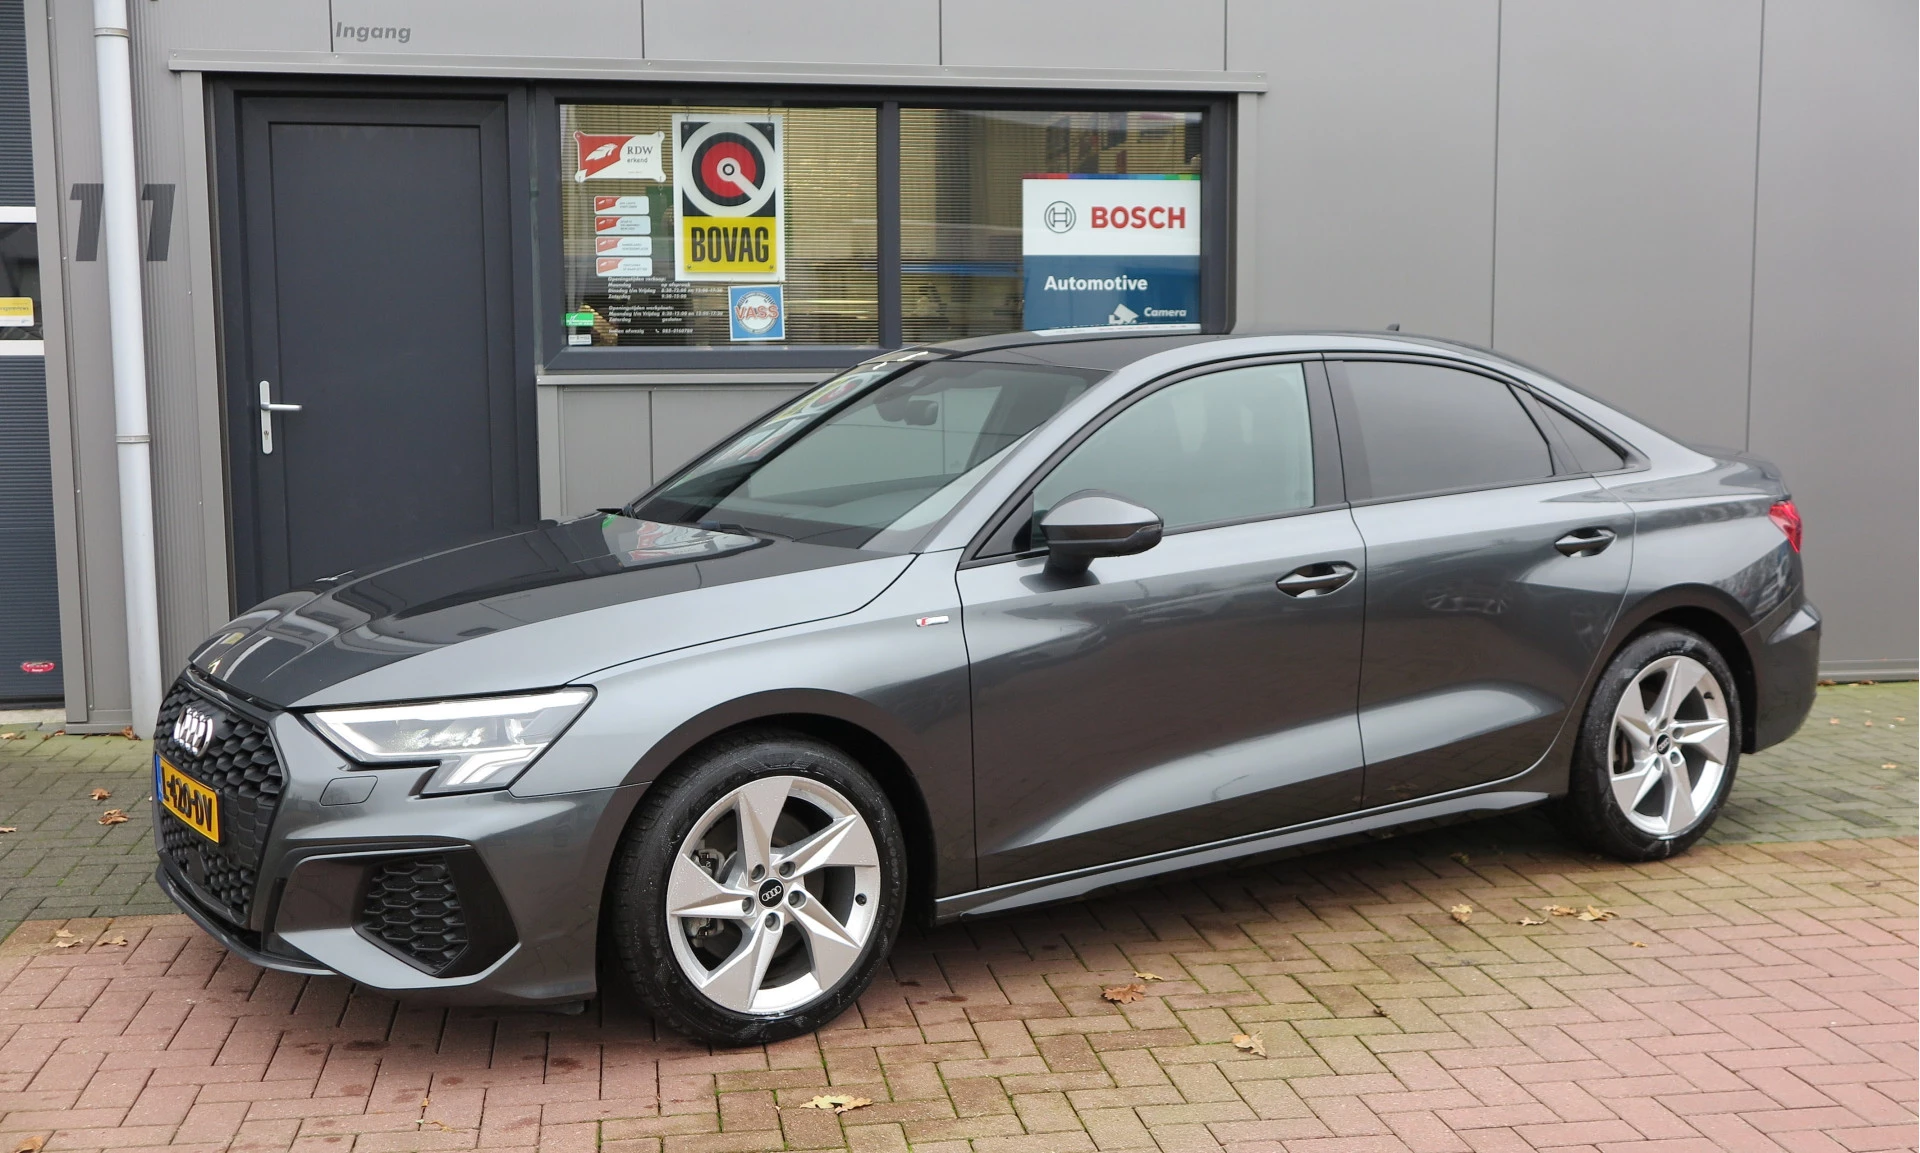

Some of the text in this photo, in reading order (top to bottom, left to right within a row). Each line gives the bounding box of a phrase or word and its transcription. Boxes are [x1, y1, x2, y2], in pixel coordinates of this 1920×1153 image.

[335, 21, 411, 43] Ingang
[627, 145, 653, 155] RDW
[69, 183, 176, 262] 11
[1090, 206, 1187, 229] BOSCH
[691, 226, 769, 262] BOVAG
[1043, 275, 1148, 292] Automotive
[734, 304, 779, 320] VASS
[1143, 306, 1187, 318] Camera
